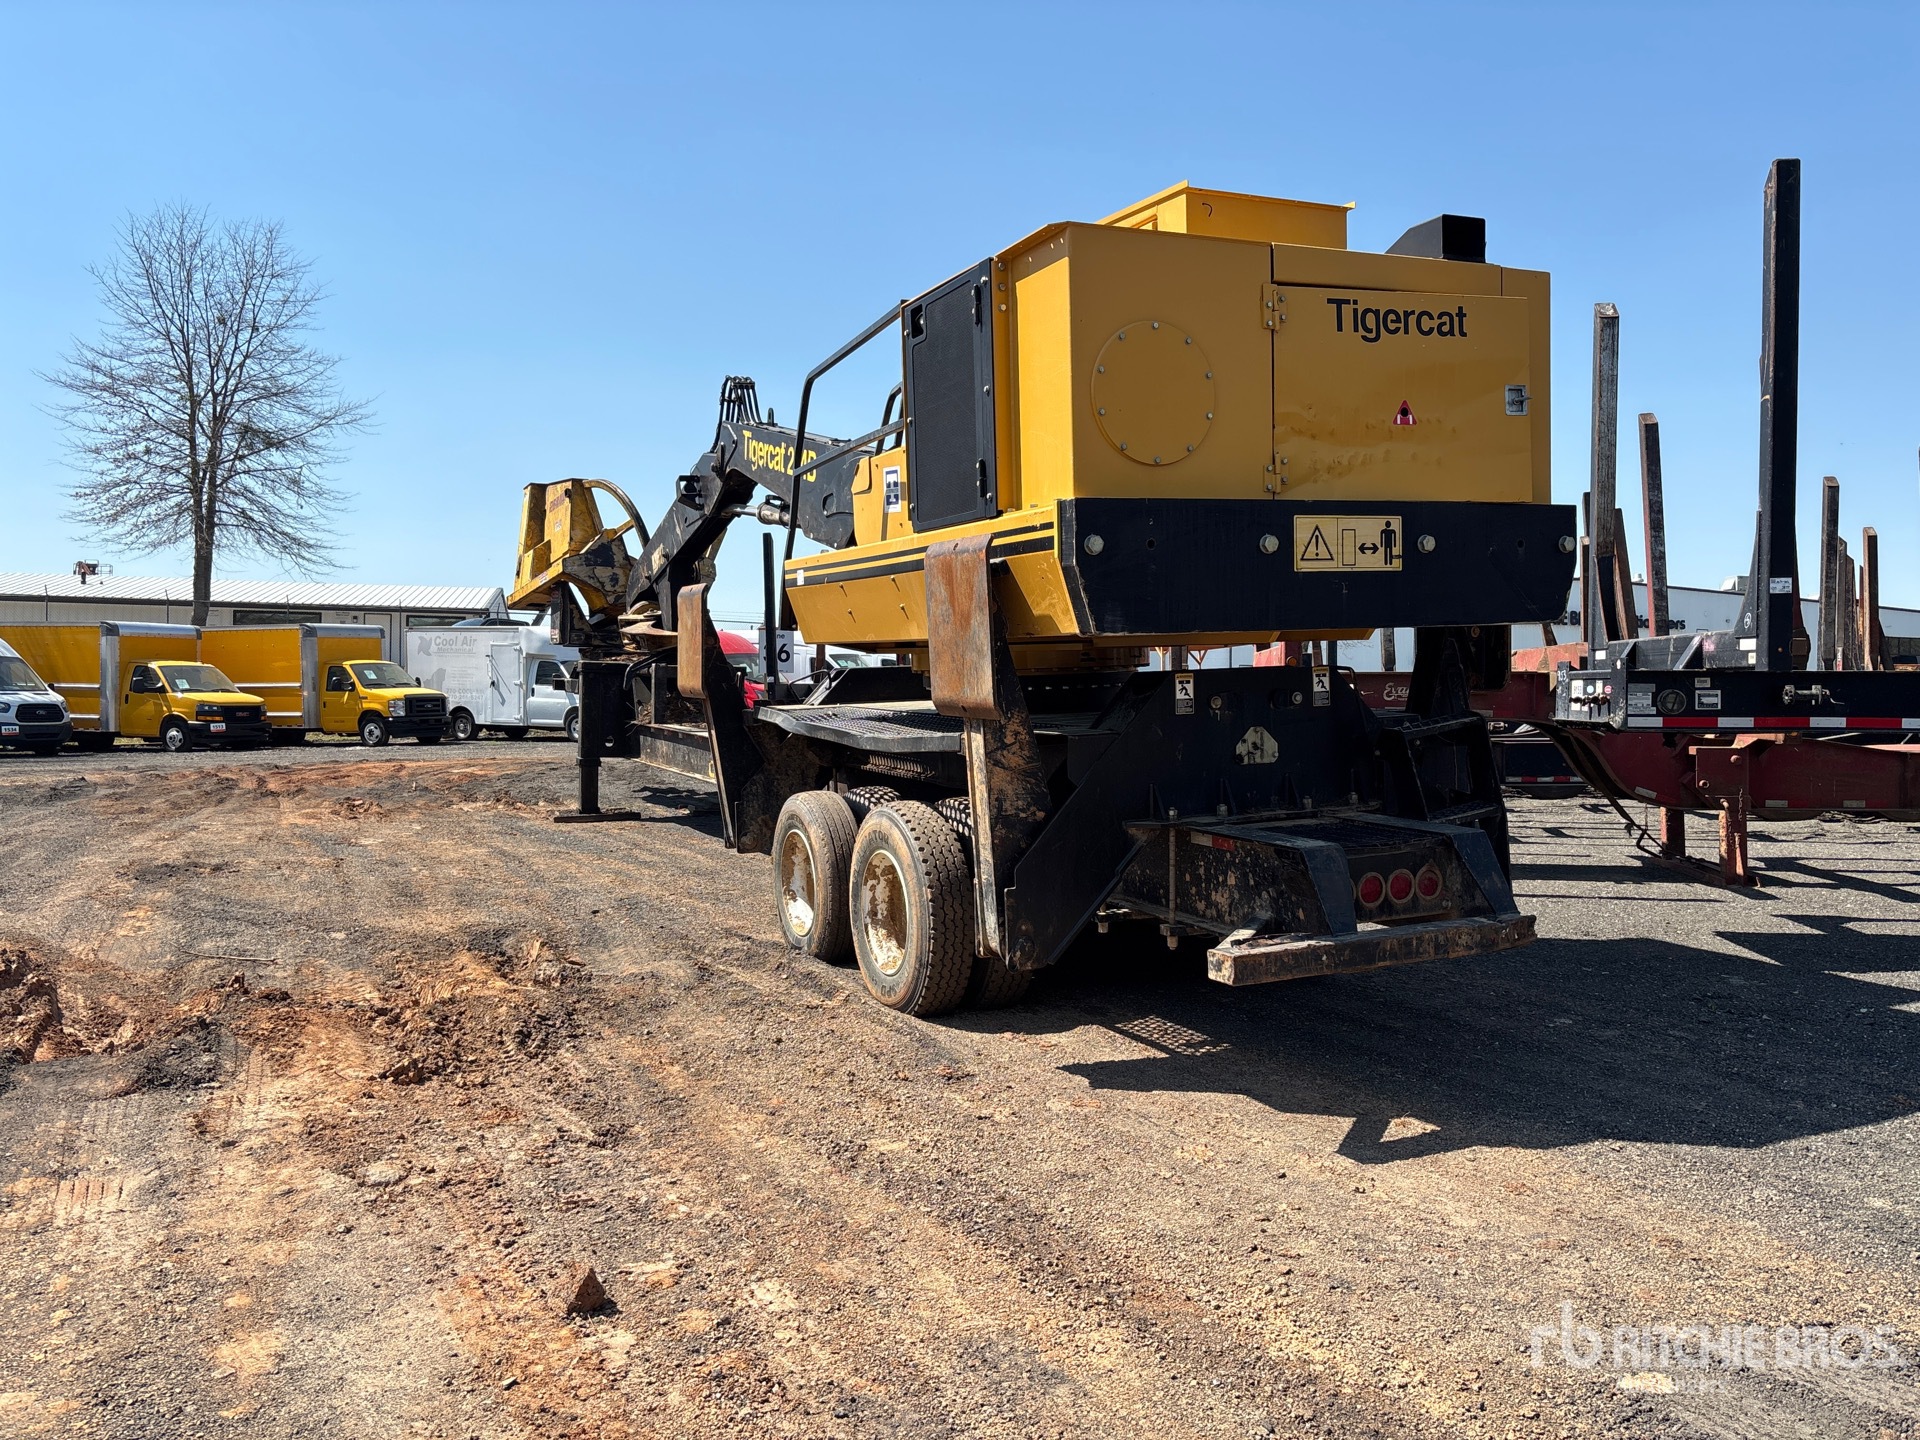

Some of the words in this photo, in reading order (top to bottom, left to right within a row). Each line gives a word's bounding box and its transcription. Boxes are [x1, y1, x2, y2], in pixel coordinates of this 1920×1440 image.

[1326, 297, 1468, 343] Tigercat
[742, 429, 785, 473] Tigercat
[434, 635, 458, 647] Cool
[461, 635, 478, 647] Air
